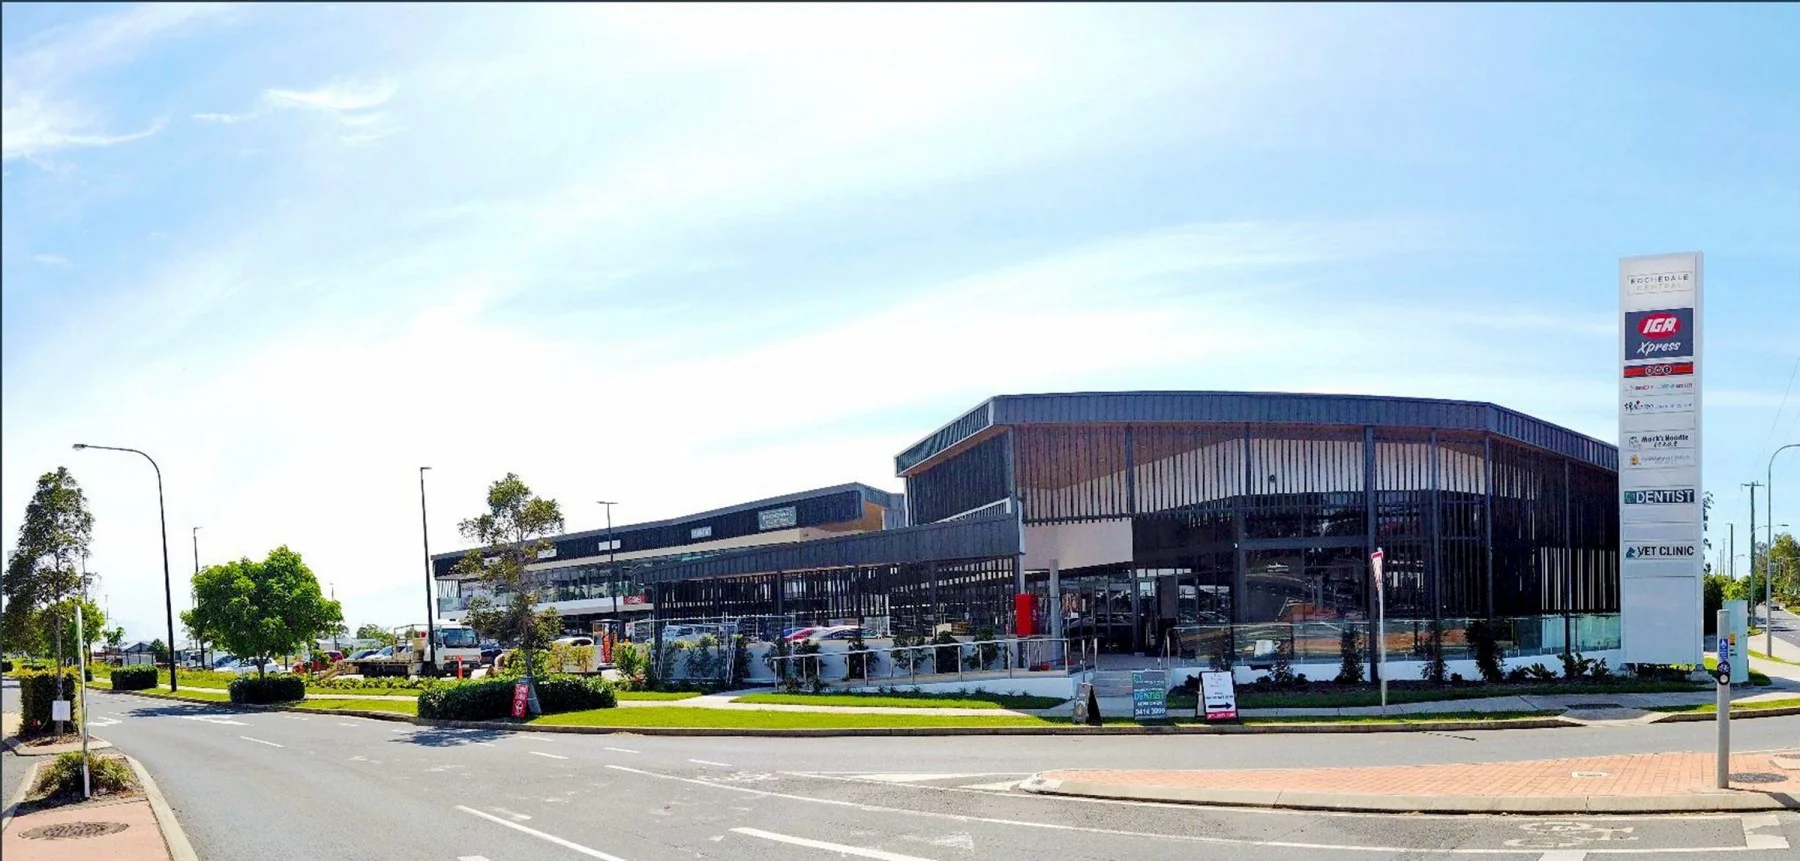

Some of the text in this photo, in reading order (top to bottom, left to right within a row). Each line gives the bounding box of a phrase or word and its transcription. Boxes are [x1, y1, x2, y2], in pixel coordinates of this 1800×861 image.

[1642, 317, 1677, 334] IGA
[1637, 341, 1681, 356] Xpress
[1636, 490, 1693, 503] DENTIST
[1637, 545, 1694, 557] VET CLINIC
[1134, 691, 1164, 700] DENTIST
